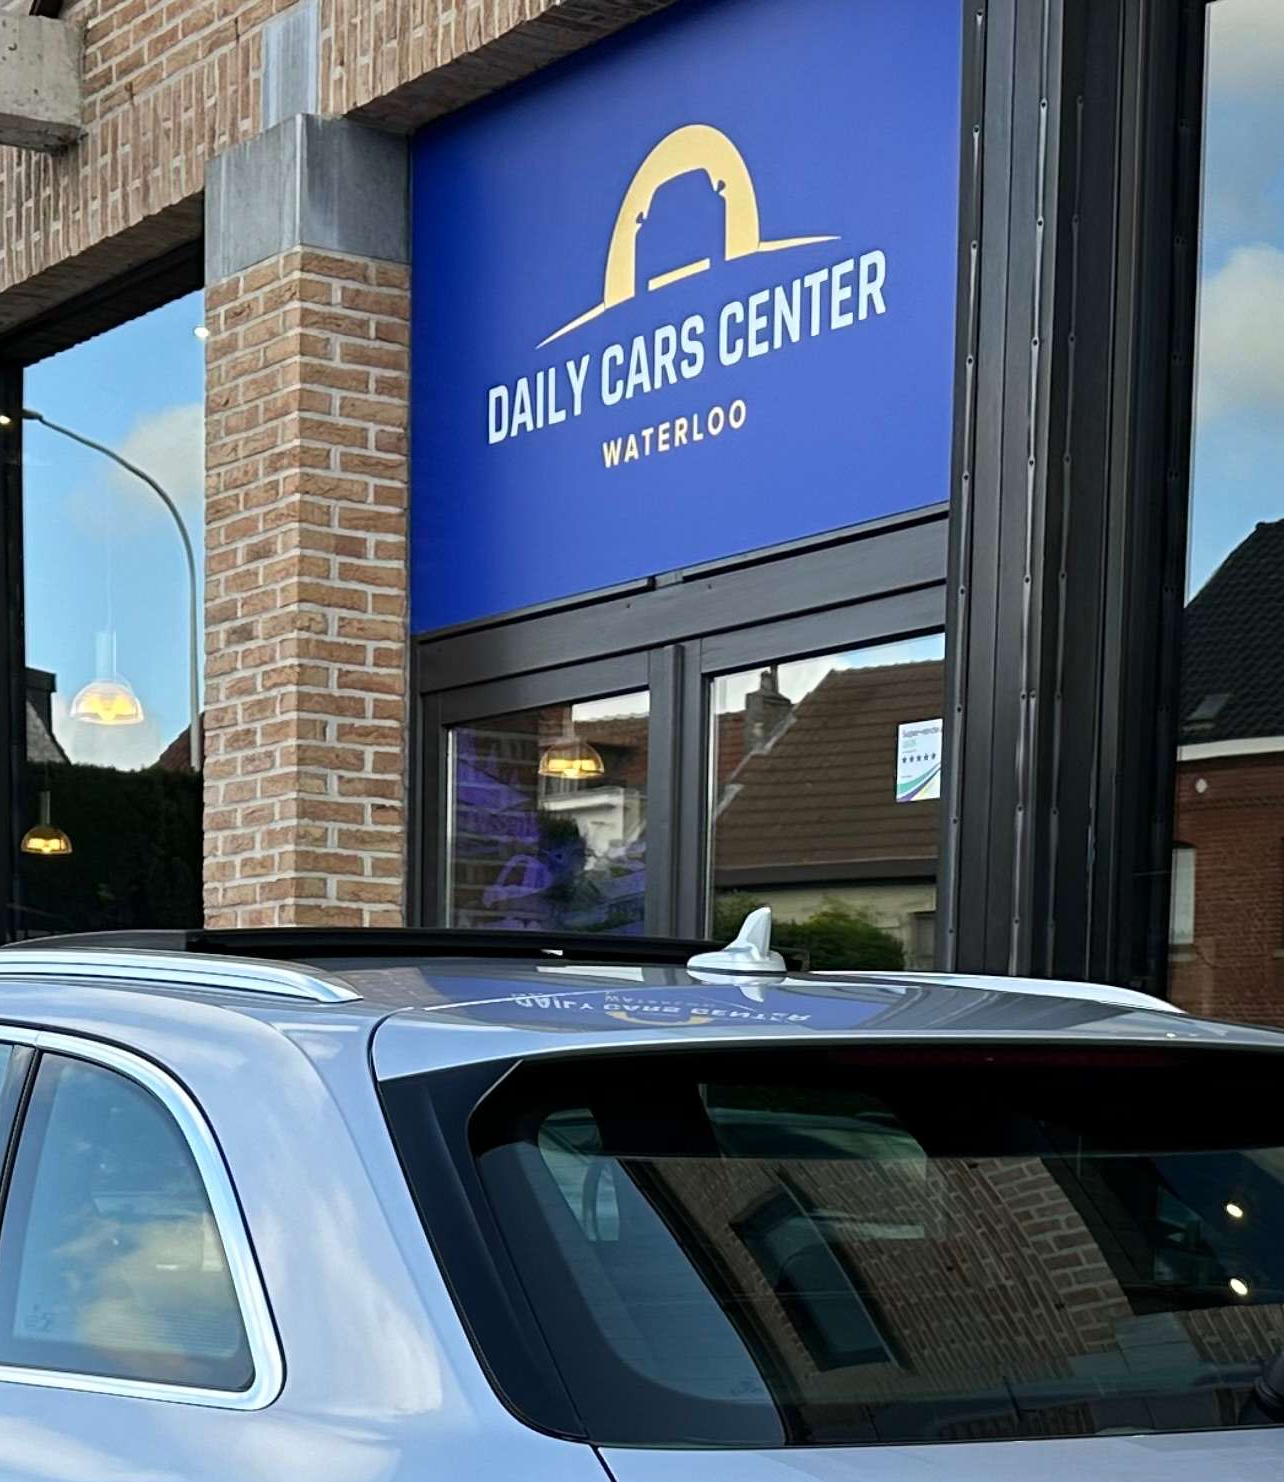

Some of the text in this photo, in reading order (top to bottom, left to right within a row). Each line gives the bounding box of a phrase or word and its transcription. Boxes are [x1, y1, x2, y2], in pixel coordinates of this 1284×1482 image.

[487, 249, 888, 445] DAILY CARS CENTER
[602, 399, 747, 469] WATERLOO
